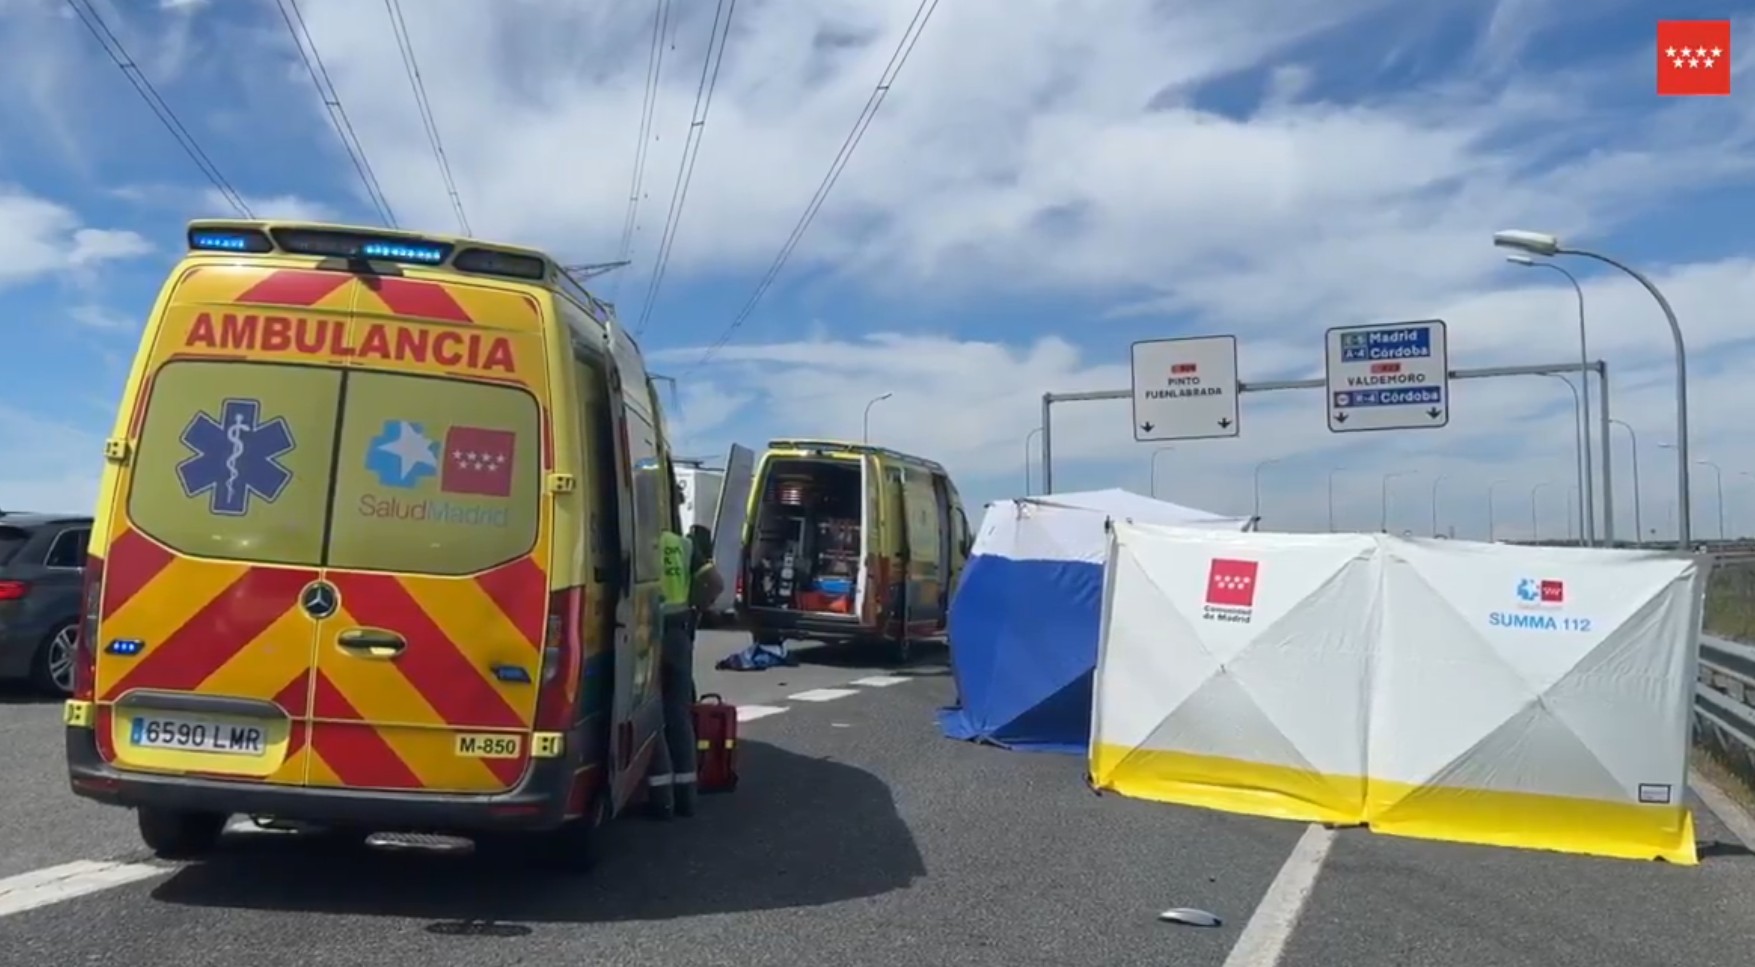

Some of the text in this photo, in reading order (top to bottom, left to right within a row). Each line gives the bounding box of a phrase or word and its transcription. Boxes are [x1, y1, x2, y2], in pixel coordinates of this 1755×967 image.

[184, 312, 516, 373] AMBULANCIA
[1369, 329, 1418, 345] Madrid
[1345, 344, 1429, 359] A-4 Córdoba
[1168, 376, 1201, 386] PINTO
[1347, 373, 1427, 387] VALDEMORO
[1145, 387, 1223, 399] FUENLABRADA
[357, 492, 511, 528] SaludMadrid
[1203, 604, 1253, 615] Comunidad
[1202, 612, 1251, 624] de Madrid
[1489, 612, 1592, 633] SUMMA 112
[145, 720, 261, 751] 6590 LMR
[459, 737, 517, 755] M-850
